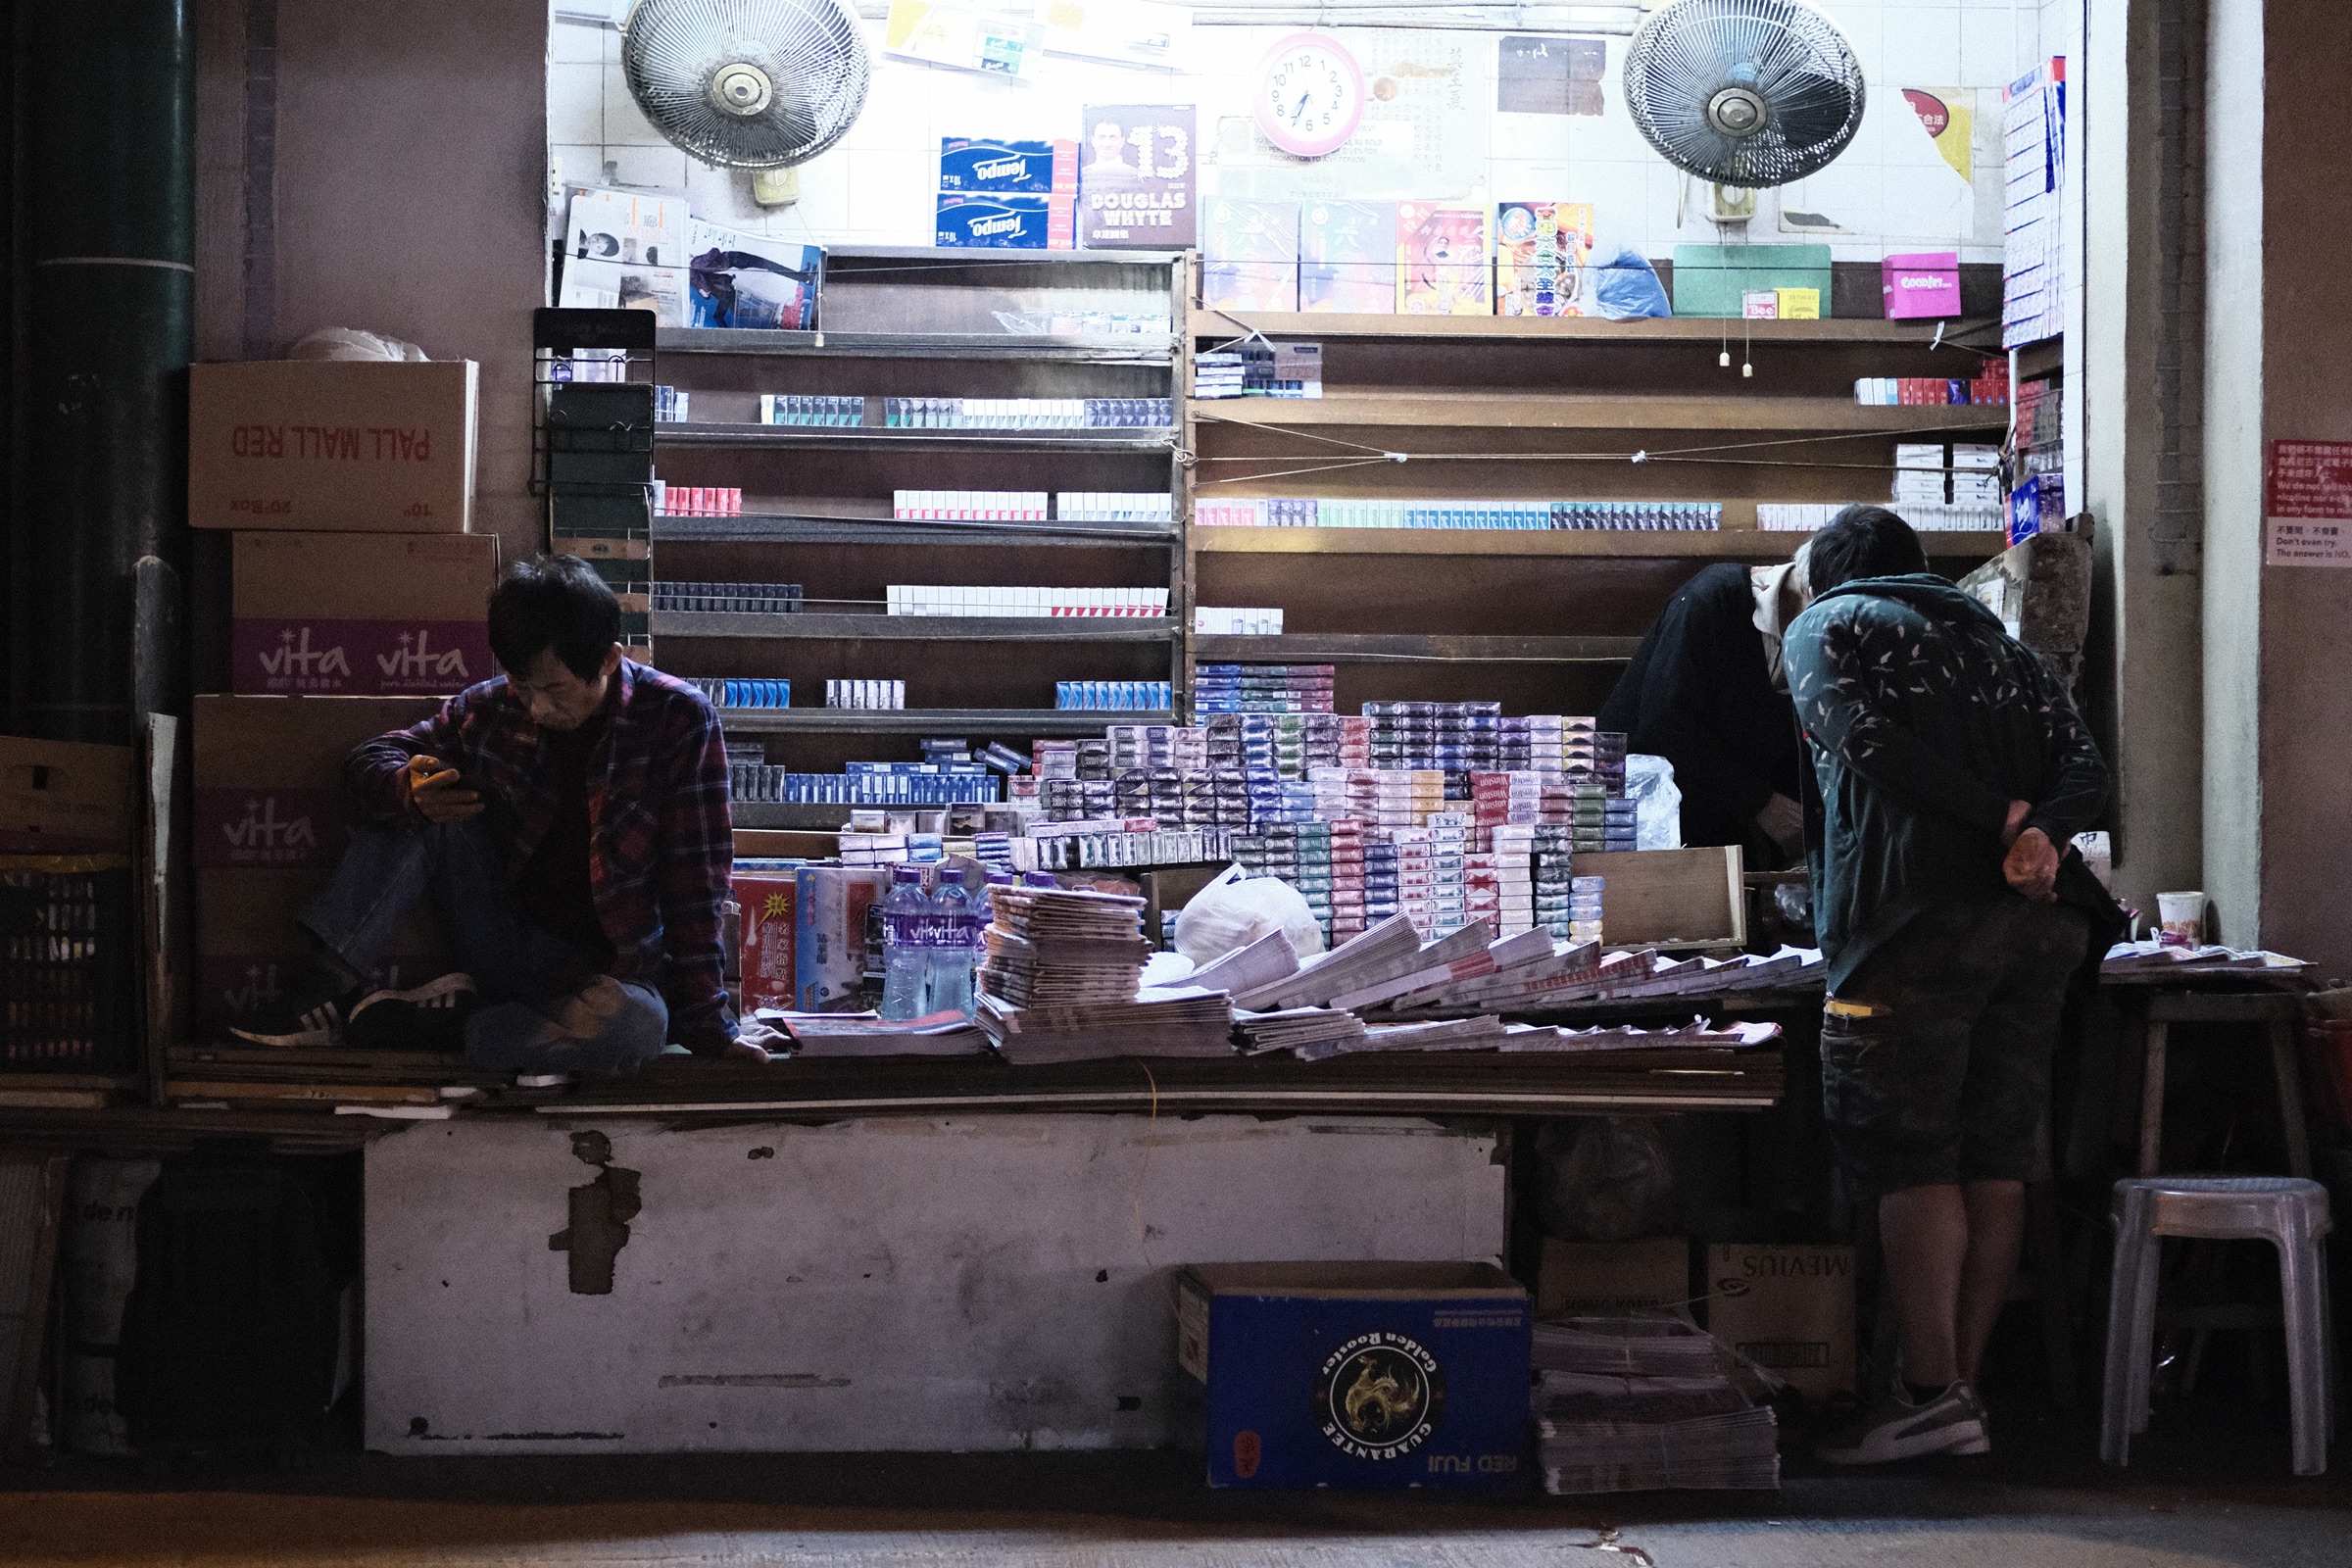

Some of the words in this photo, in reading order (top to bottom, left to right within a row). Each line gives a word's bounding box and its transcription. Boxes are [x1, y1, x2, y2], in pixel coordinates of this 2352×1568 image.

[1284, 61, 1294, 74] 11
[1298, 55, 1311, 68] 12
[1320, 59, 1326, 71] 1
[1273, 74, 1286, 86] 10
[1329, 72, 1337, 83] 2
[1272, 90, 1279, 102] 9
[1335, 85, 1343, 97] 3
[1277, 104, 1284, 117] 8
[1331, 100, 1339, 111] 4
[1305, 120, 1313, 131] 6
[1323, 113, 1331, 124] 5
[1127, 124, 1190, 179] 13
[972, 156, 1032, 182] Tempo
[1091, 192, 1187, 210] DOUGLAS
[968, 211, 1027, 239] Tempo
[1102, 210, 1173, 226] WHYTE
[1749, 305, 1773, 315] Bee
[231, 425, 284, 459] RED
[291, 426, 360, 461] MALL
[368, 427, 431, 461] PALL
[2277, 537, 2300, 546] Don't
[2277, 549, 2291, 558] The
[259, 626, 351, 678] vita
[376, 629, 469, 678] vita
[1481, 776, 1507, 786] Winston
[1480, 789, 1507, 798] Winston
[1479, 800, 1507, 809] Winston
[222, 796, 318, 849] vita
[1477, 816, 1505, 826] Winston
[933, 917, 969, 940] vita
[1742, 1255, 1847, 1278] MEVIUS
[1323, 1332, 1381, 1376] Rooster
[1386, 1332, 1438, 1374] Golden
[1322, 1422, 1432, 1461] GUARANTEE
[1428, 1455, 1471, 1473] FUJI
[1478, 1455, 1518, 1473] RED
